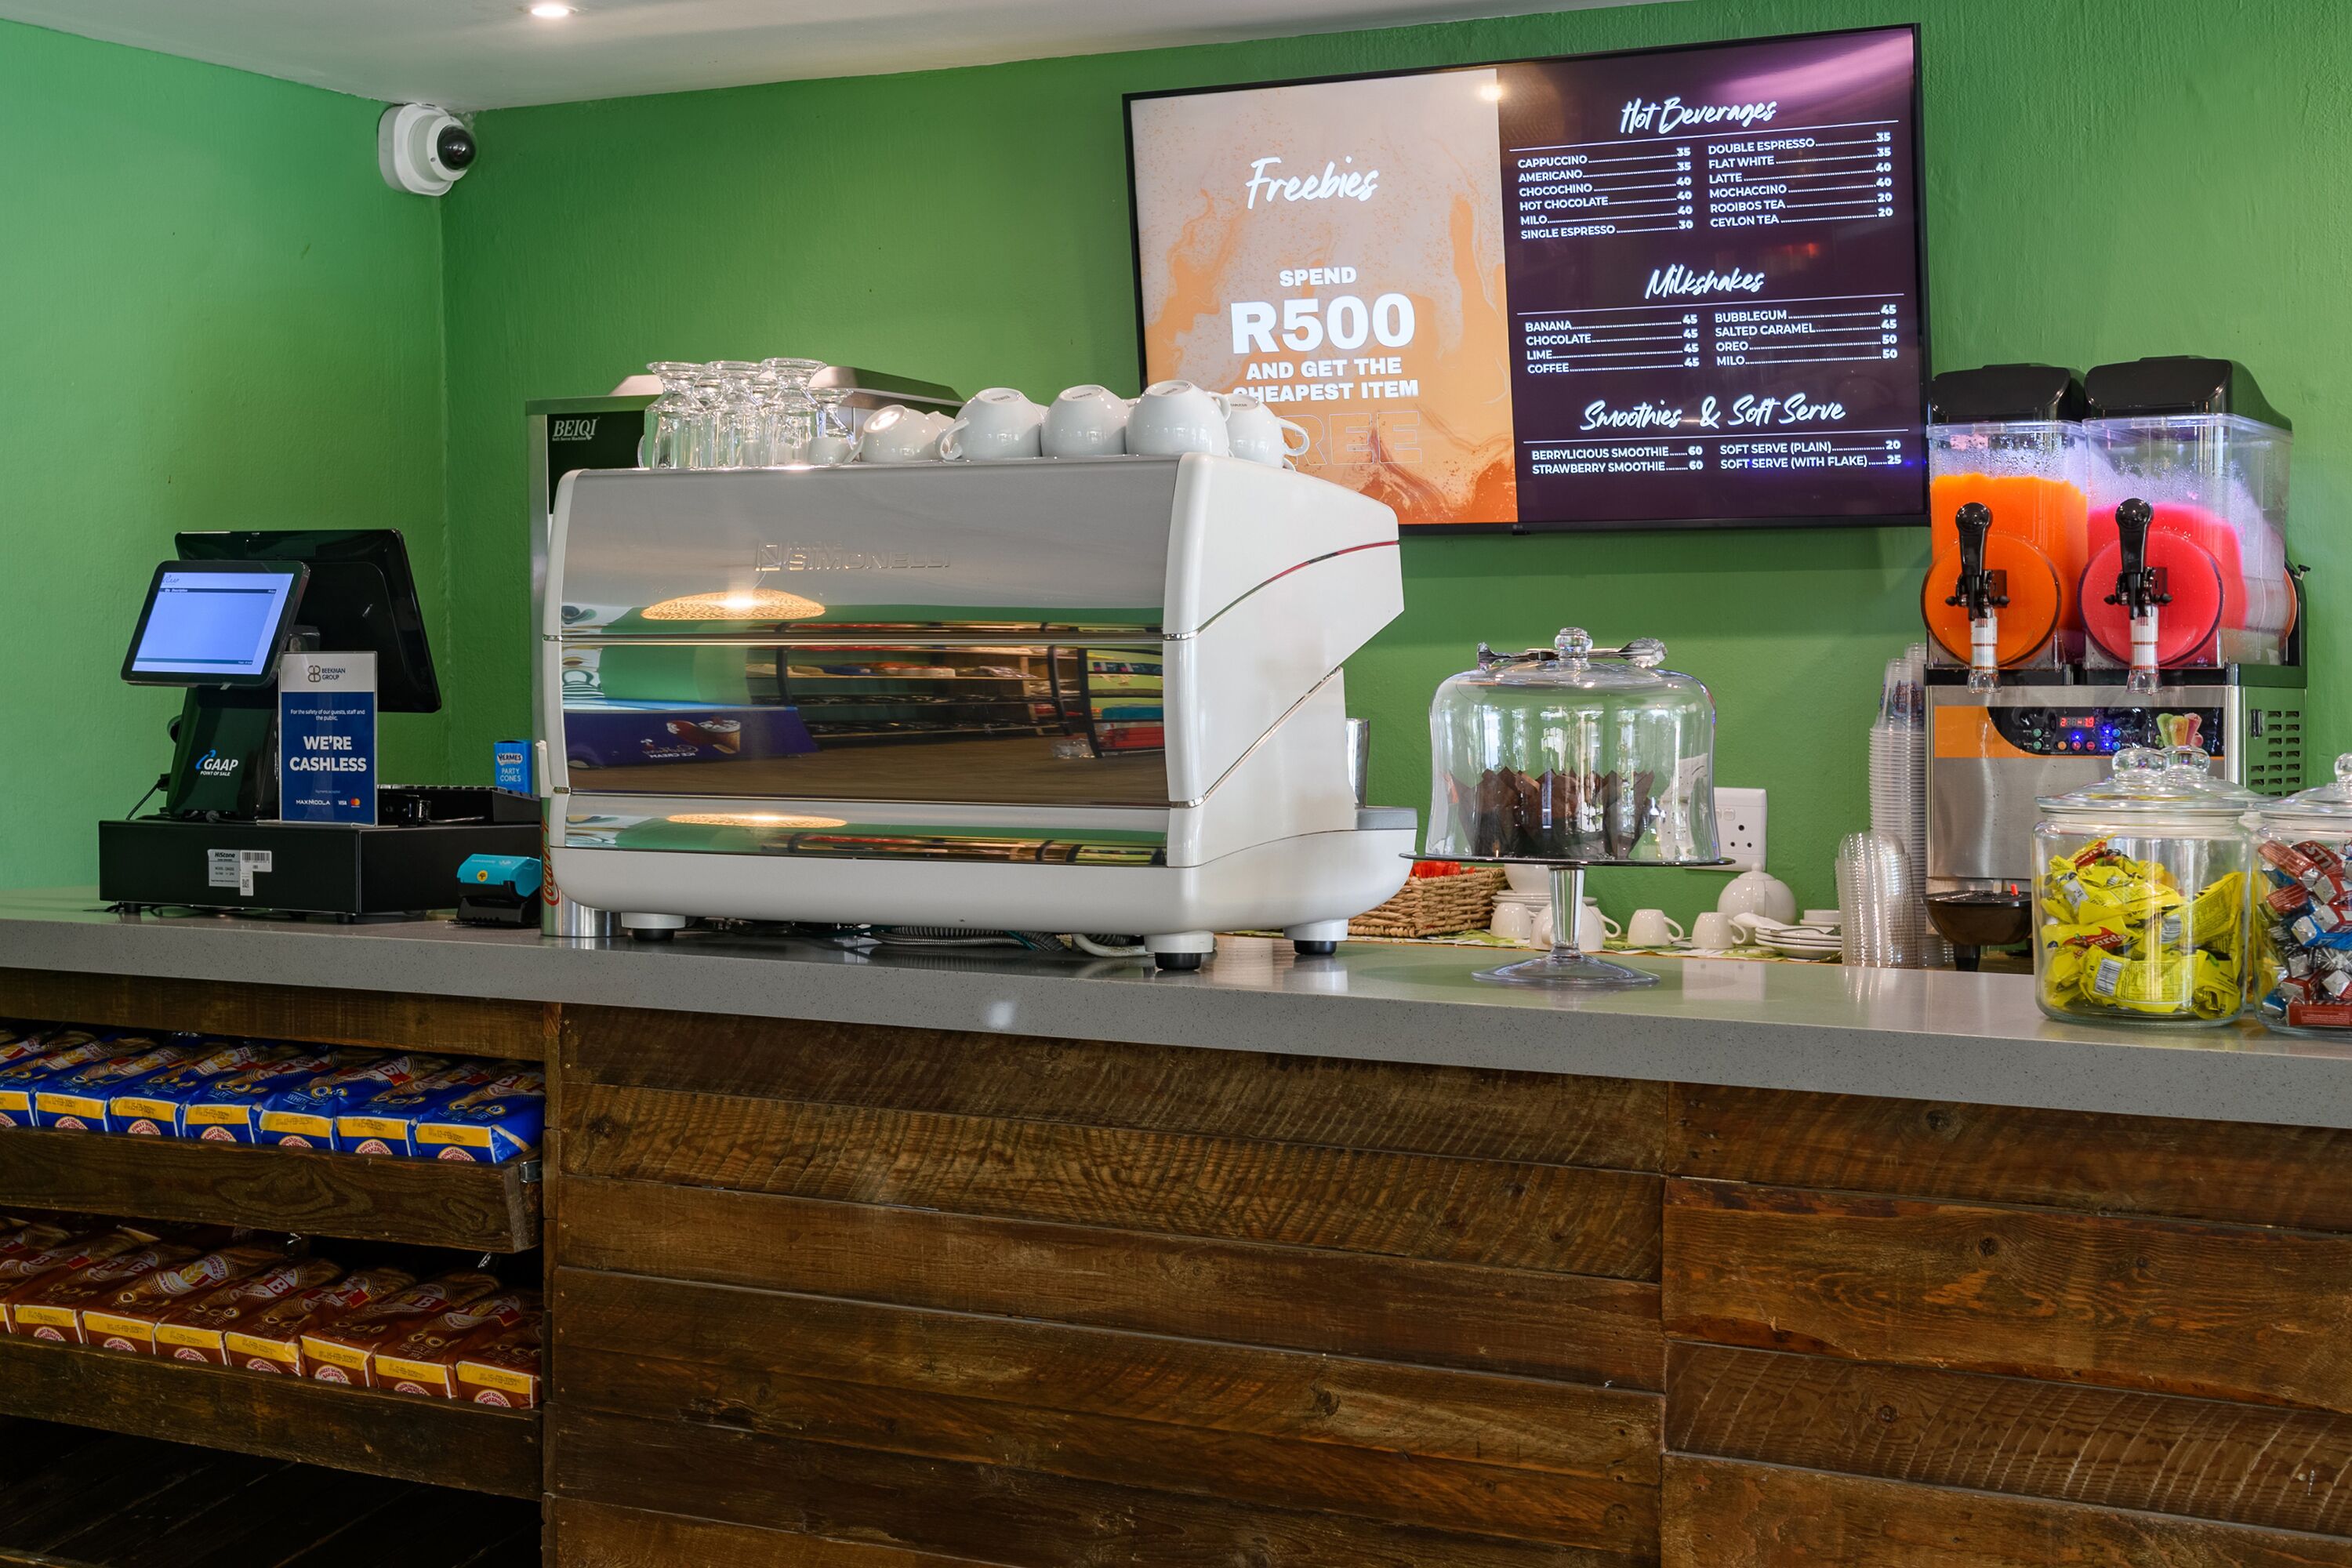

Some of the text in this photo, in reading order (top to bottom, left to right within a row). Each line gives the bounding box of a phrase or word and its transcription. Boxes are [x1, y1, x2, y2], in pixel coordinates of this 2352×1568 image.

[1621, 97, 1777, 133] Hot Beverages
[1708, 132, 1890, 154] DOUBLE ESPRESSO 35
[1518, 147, 1690, 168] CAPPUCCINO 35
[1709, 147, 1891, 169] FLAT WHITE 35
[1519, 162, 1691, 182] AMERICANO 35
[1709, 162, 1891, 183] LATTE 40
[1246, 157, 1378, 209] Freebies
[1519, 177, 1691, 197] CHOCOCHINO 40
[1710, 178, 1892, 198] MOCHACCINO 40
[1520, 191, 1692, 211] HOT CHOCOLATE 40
[1711, 193, 1892, 213] ROOIBOS TEA 20
[1521, 205, 1693, 225] MILO 40
[1711, 207, 1893, 227] CEYLON TEA 20
[1521, 220, 1693, 239] SINGLE ESPRESSO 30
[1280, 267, 1356, 286] SPEND
[1645, 264, 1764, 299] Milkshakes
[1232, 294, 1414, 353] R500
[1526, 314, 1697, 332] BANANA 45
[1715, 304, 1896, 323] BUBBLEGUM 45
[1526, 328, 1698, 345] CHOCOLATE 45
[1715, 319, 1896, 336] SALTED CARAMEL 45
[1527, 343, 1699, 360] LIME 45
[1716, 335, 1897, 351] OREO 50
[1527, 358, 1700, 373] COFFEE 45
[1717, 349, 1897, 365] MILO 50
[1247, 358, 1401, 379] AND GET THE
[1361, 379, 1419, 399] ITEM
[1581, 393, 1846, 430] Smoothies & Soft Serve
[552, 419, 597, 440] BEIQI
[1279, 411, 1422, 466] REE
[1532, 446, 1703, 459] BERRYLICIOUS SMOOTHIE 60
[1720, 441, 1900, 455] SOFT SERVE (PLAIN) 20
[1533, 460, 1703, 474] STRAWBERRY SMOOTHIE 60
[1721, 455, 1901, 469] SOFT SERVE (WITH FLAKE) 25
[303, 735, 352, 750] WE'RE
[204, 758, 238, 771] GAAP
[289, 757, 367, 771] CASHLESS
[287, 1094, 309, 1104] WHITE
